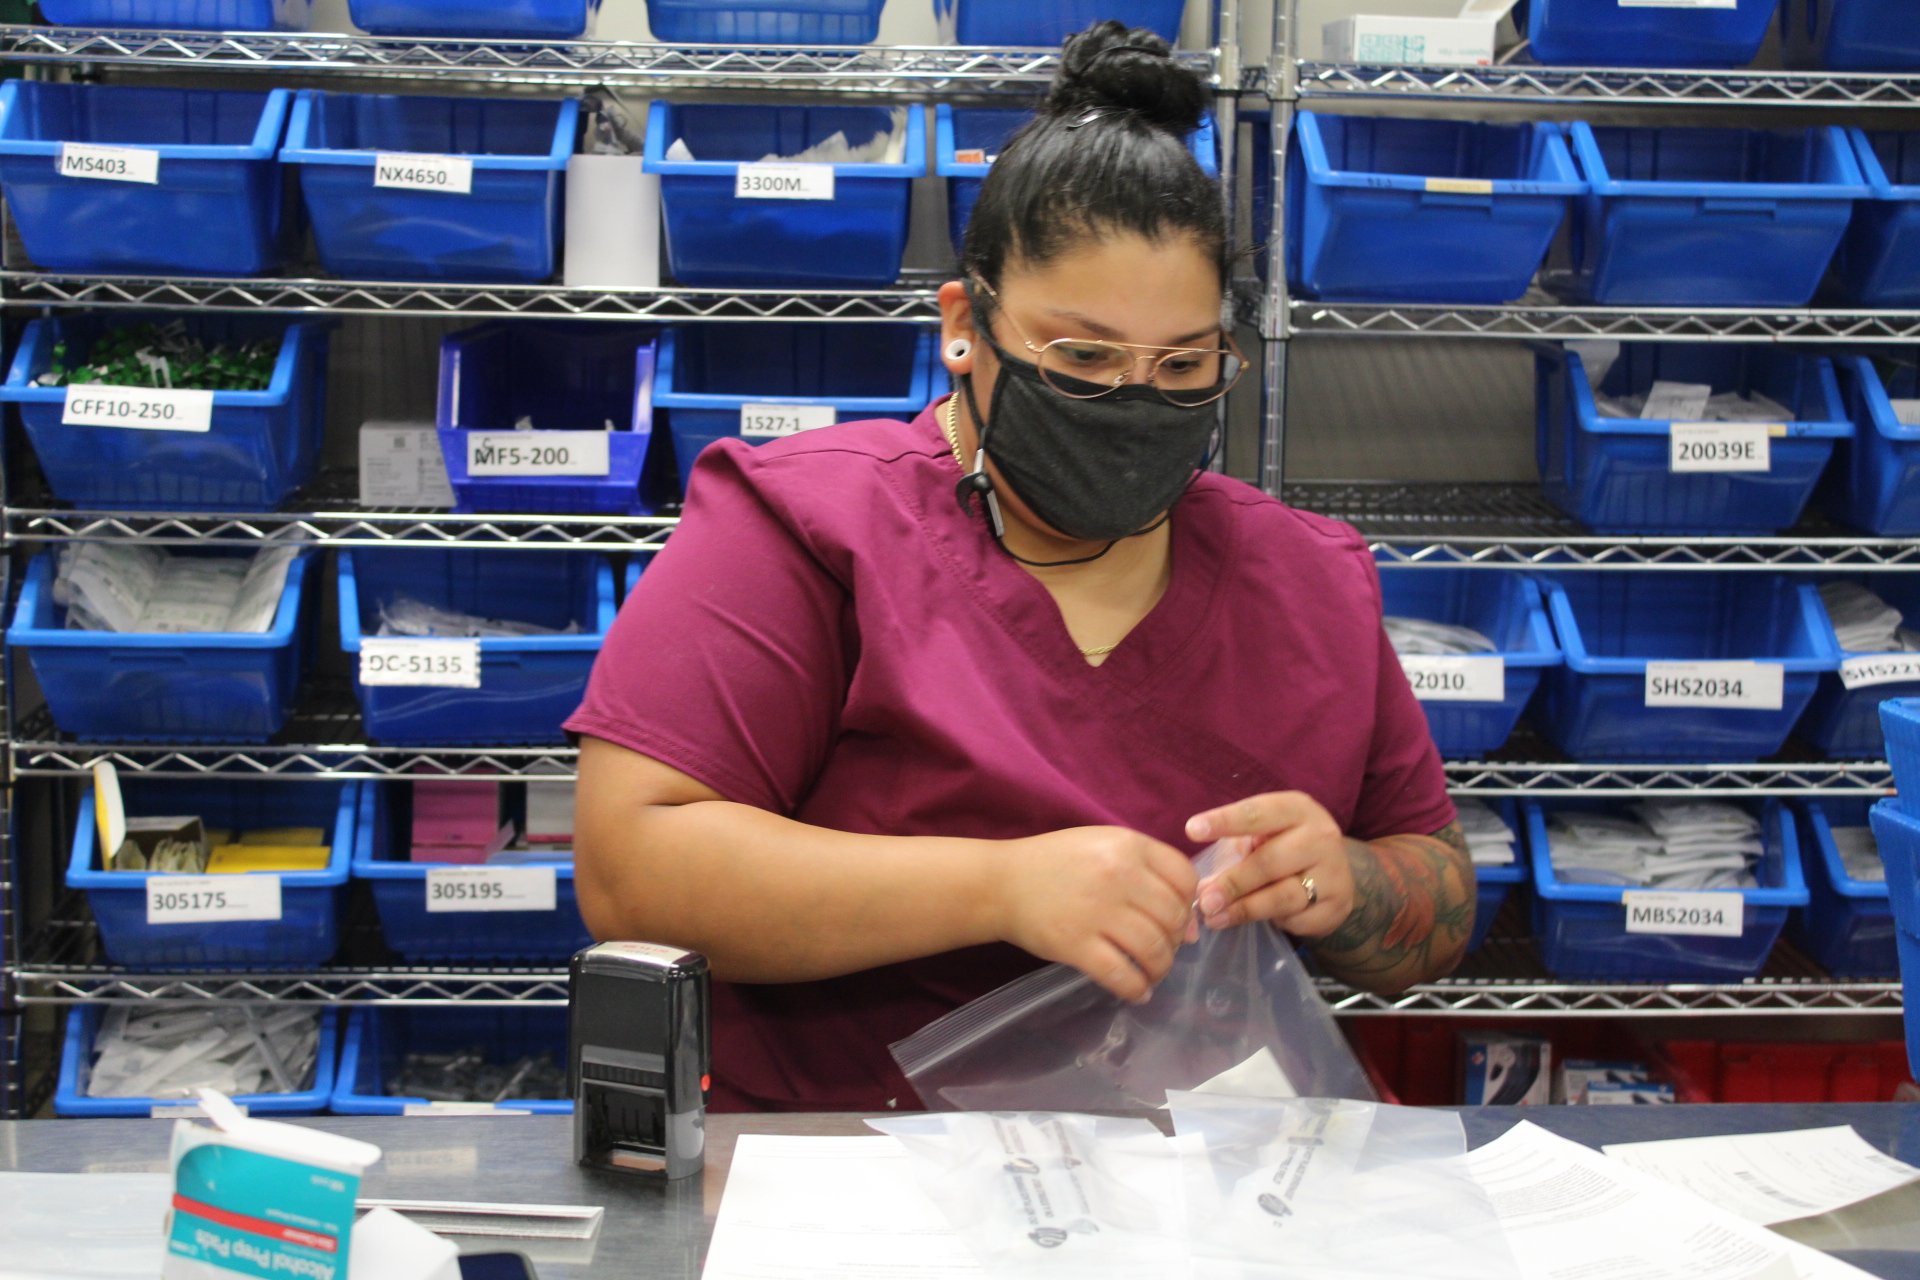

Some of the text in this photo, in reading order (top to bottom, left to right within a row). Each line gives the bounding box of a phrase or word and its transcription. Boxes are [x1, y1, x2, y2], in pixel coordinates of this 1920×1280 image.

[66, 155, 126, 175] MS403
[379, 165, 447, 186] NX4650
[741, 175, 801, 193] 3300M
[70, 398, 175, 421] CFF10-250
[1678, 441, 1756, 461] 20039E
[369, 654, 462, 673] DC-5135
[1651, 677, 1744, 698] SHS2034
[152, 892, 227, 910] 305175
[431, 882, 503, 900] 305195
[1632, 906, 1724, 926] MBS2034
